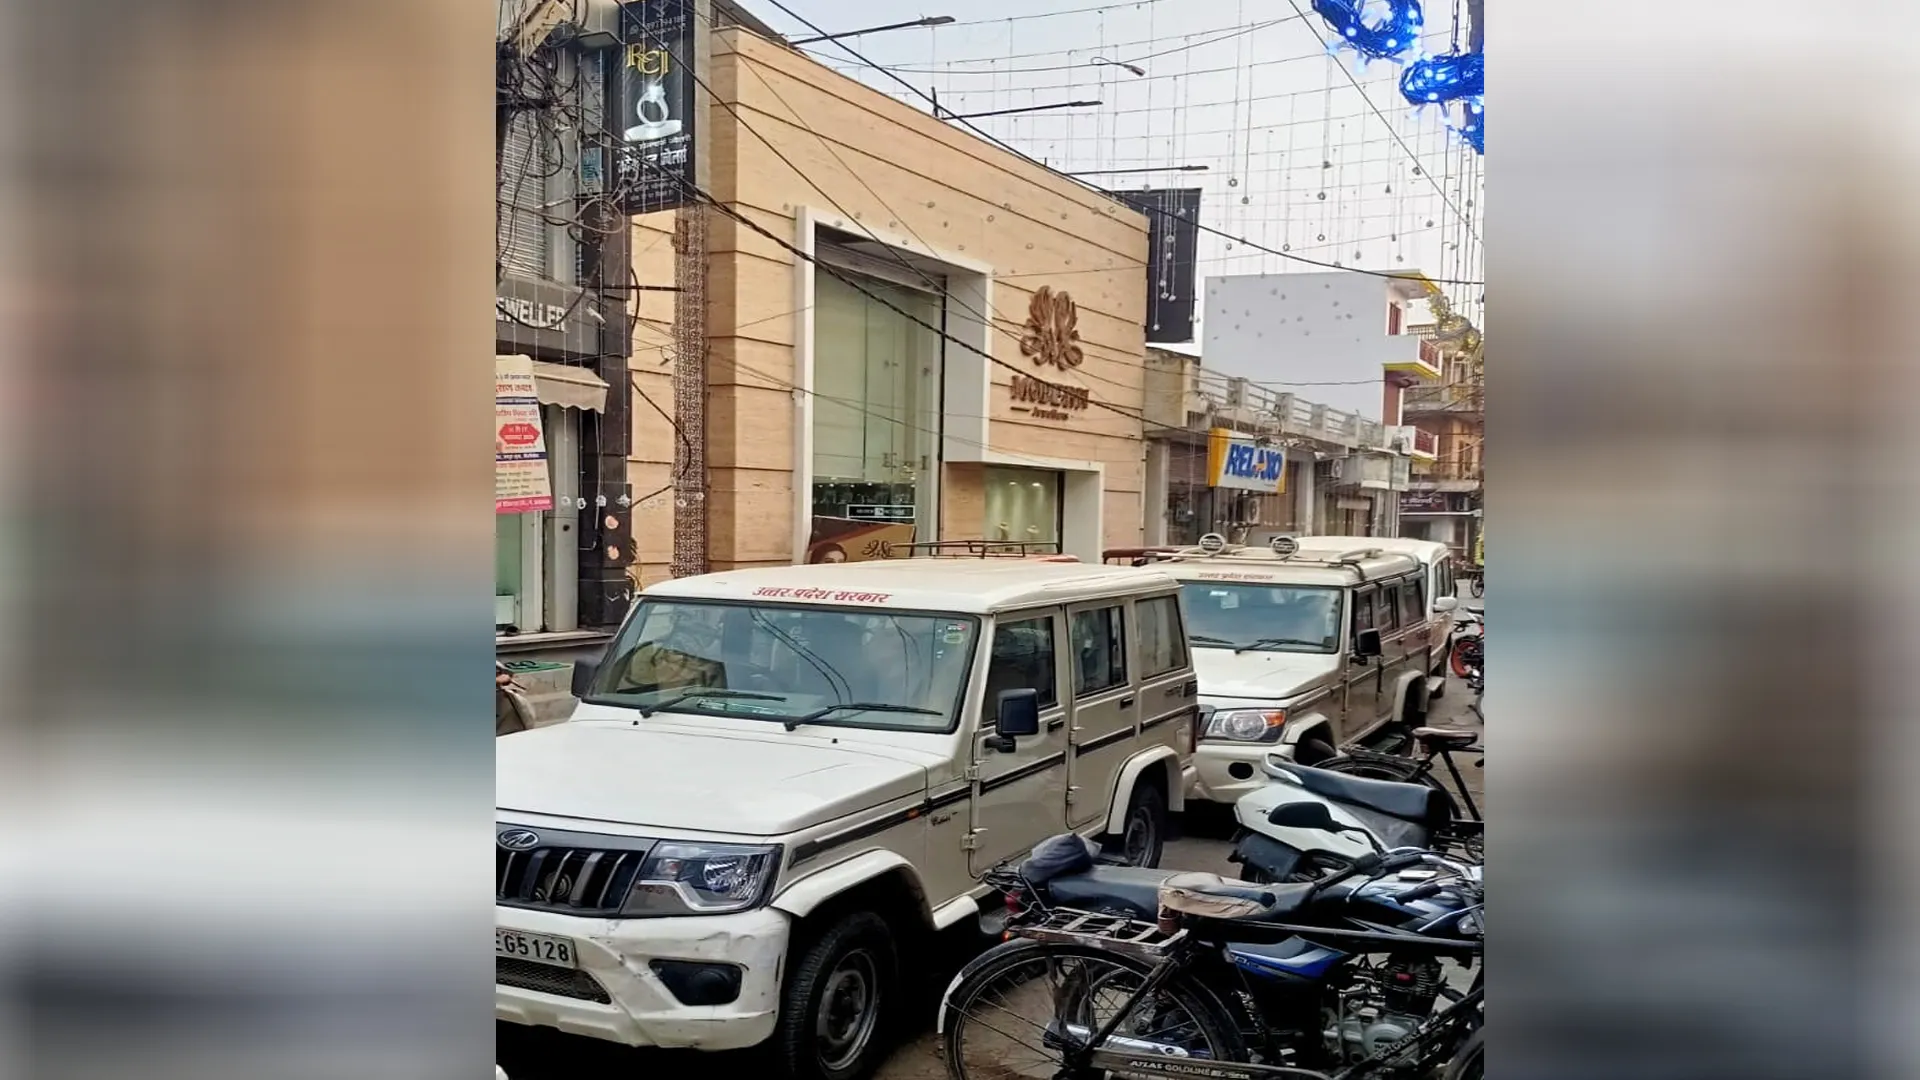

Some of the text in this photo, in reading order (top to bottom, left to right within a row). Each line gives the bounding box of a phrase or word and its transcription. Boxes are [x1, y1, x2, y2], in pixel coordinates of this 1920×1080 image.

[1224, 443, 1283, 481] RELAXO
[752, 586, 894, 603] उत्तर प्रदेश सरकार
